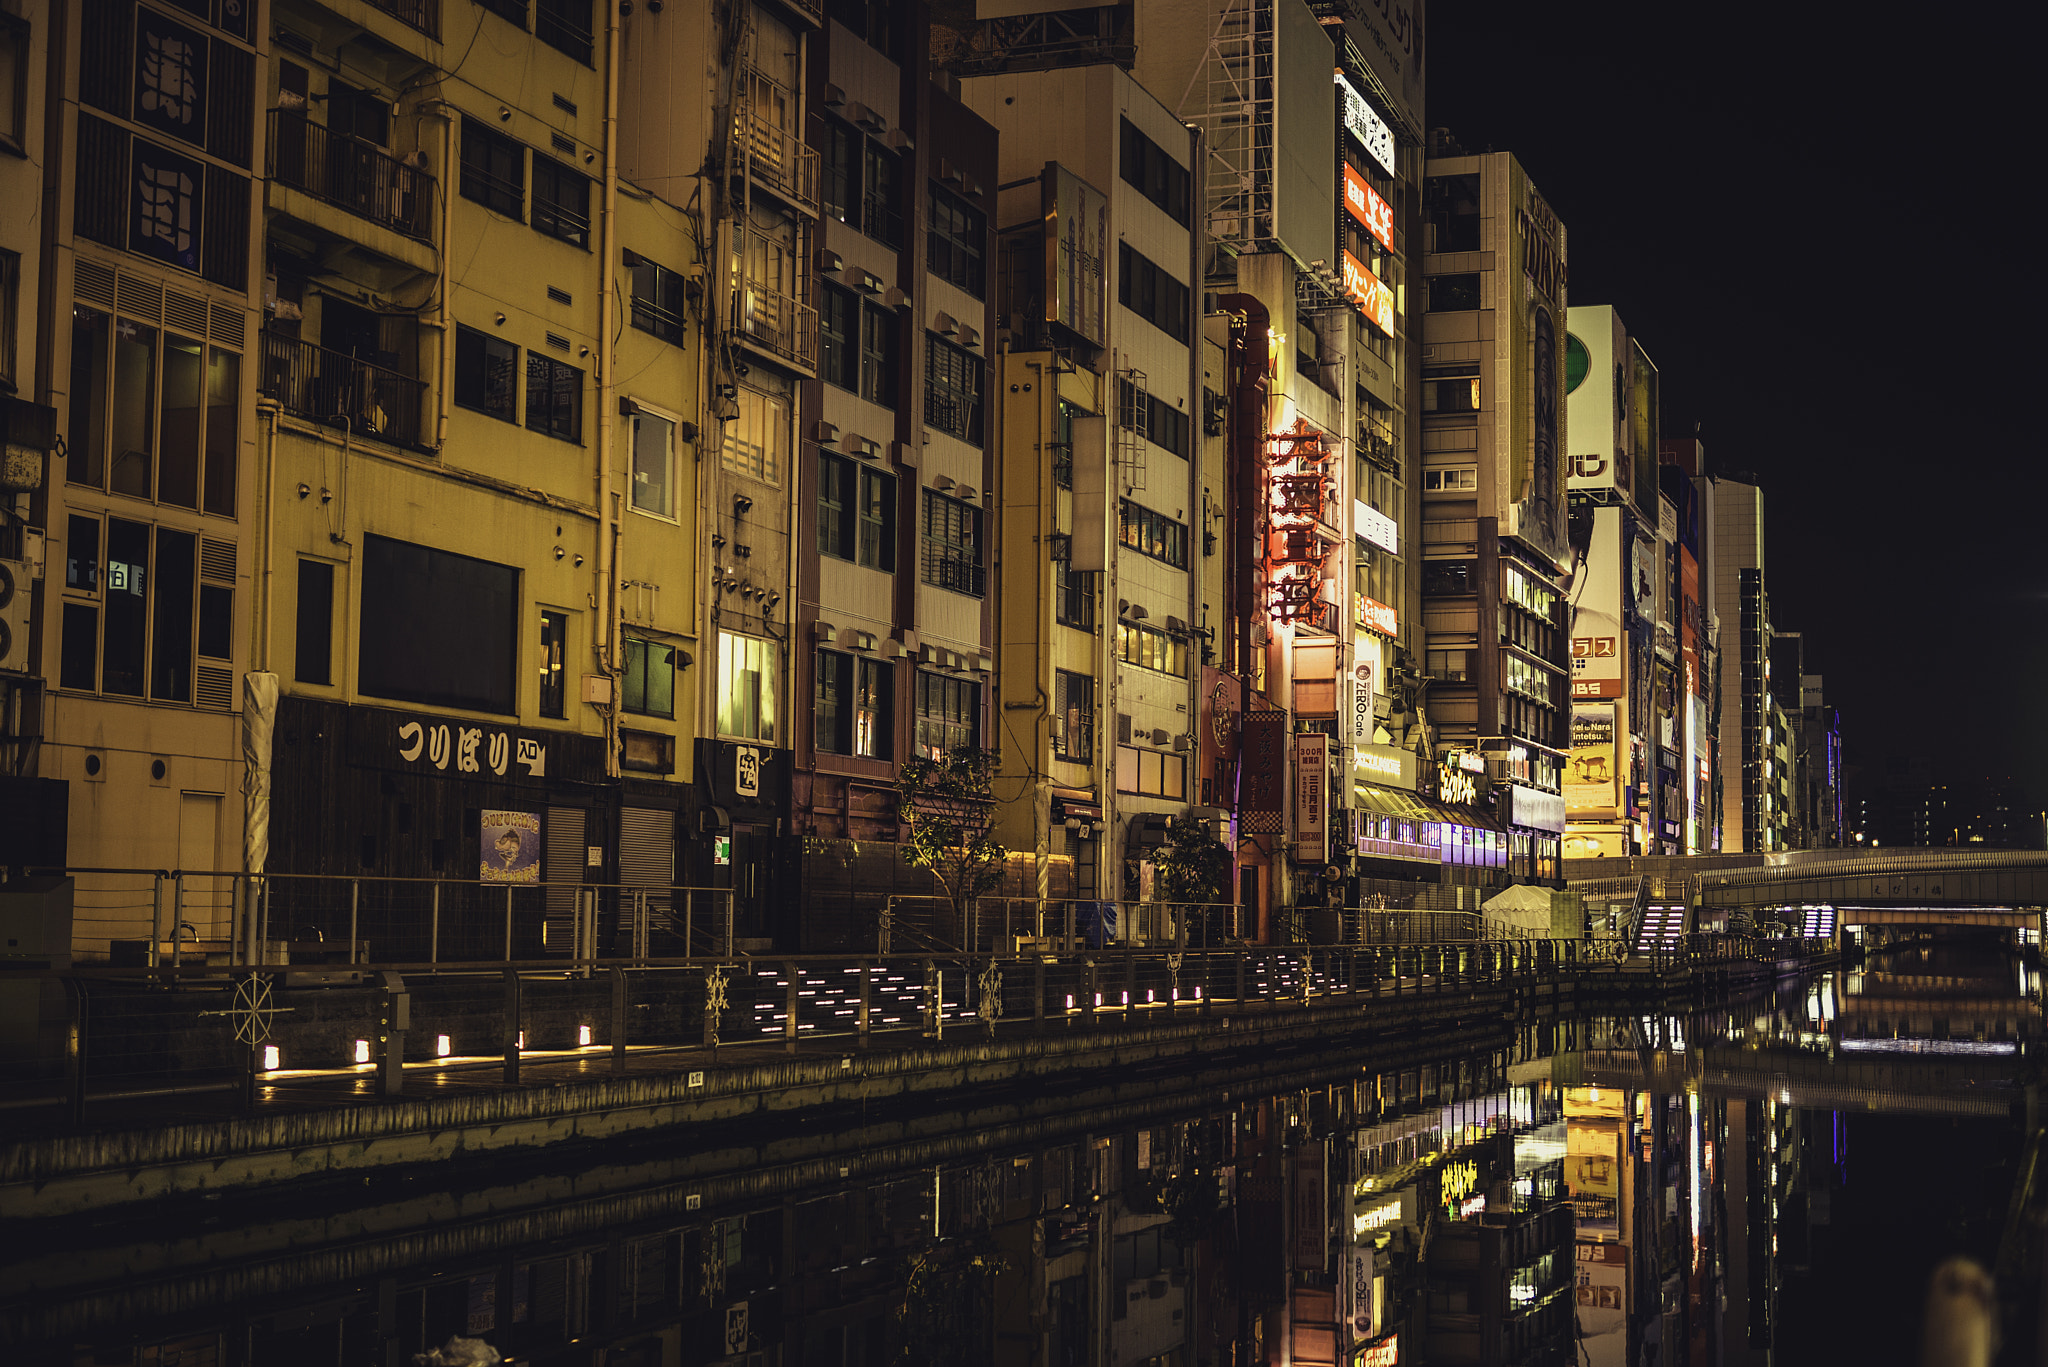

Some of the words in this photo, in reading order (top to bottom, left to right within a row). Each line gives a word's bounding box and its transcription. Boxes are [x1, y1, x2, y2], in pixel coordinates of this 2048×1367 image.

[1356, 682, 1367, 713] ZERO
[1355, 714, 1364, 737] cafe
[1591, 723, 1611, 731] Nara
[399, 721, 509, 776] つりぼり
